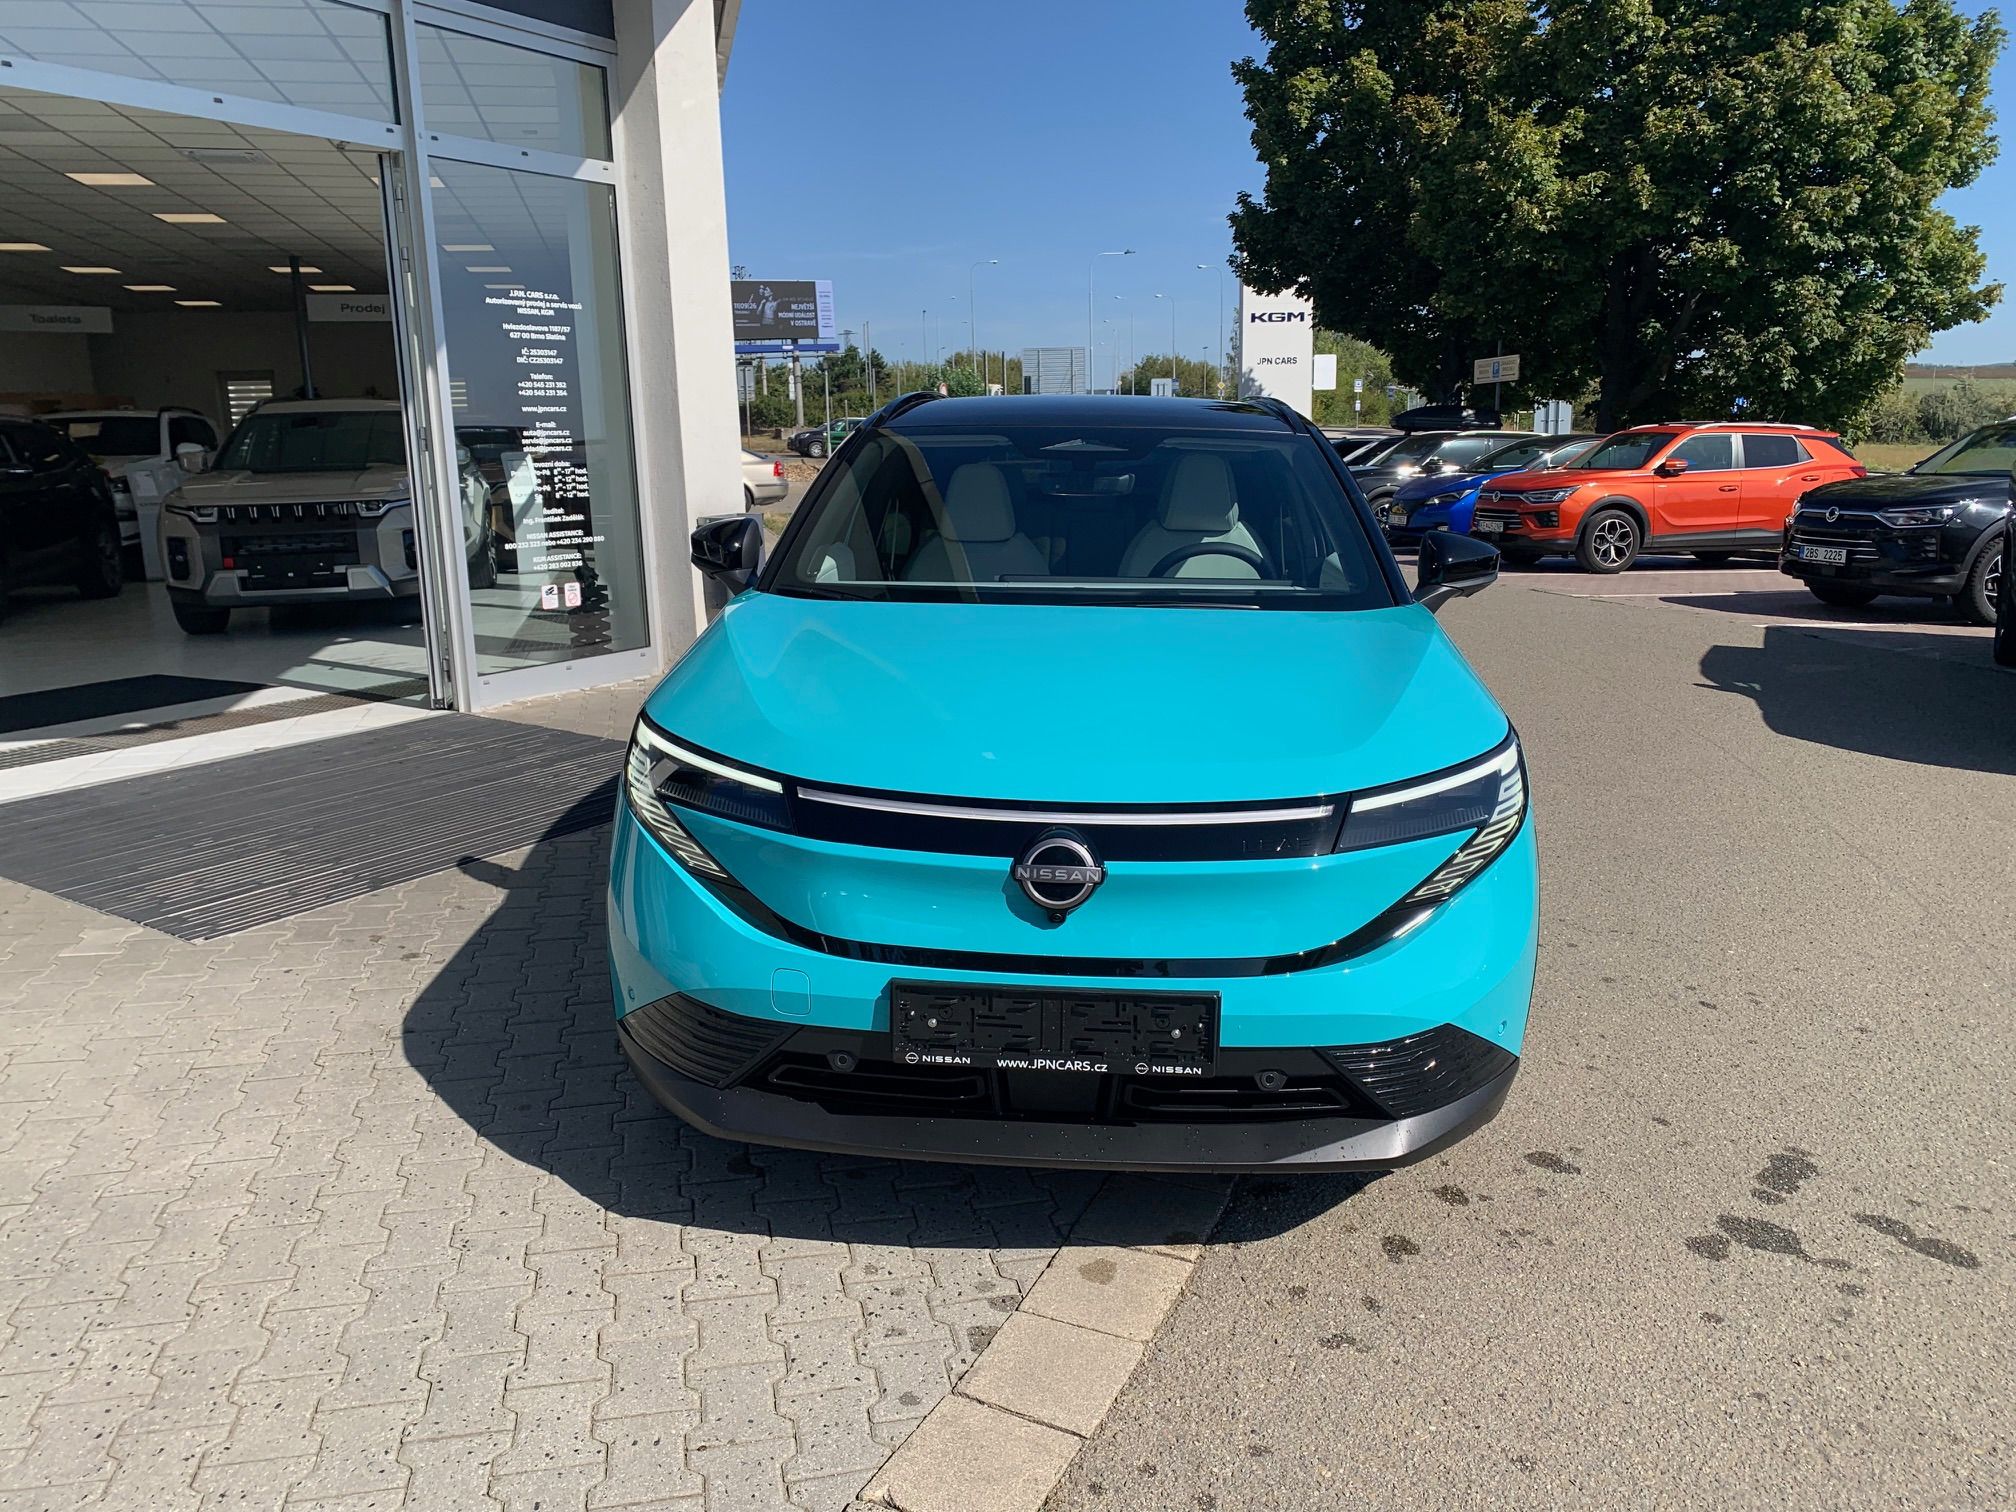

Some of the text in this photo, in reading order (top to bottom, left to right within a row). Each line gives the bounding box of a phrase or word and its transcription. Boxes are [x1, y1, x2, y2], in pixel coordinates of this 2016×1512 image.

[485, 297, 526, 306] Autorizovaný
[526, 300, 546, 308] prodej
[340, 303, 385, 315] Prodej
[29, 313, 82, 324] Toaleta
[1250, 312, 1305, 322] KGM
[502, 323, 548, 332] Hviezdoslavova
[1257, 357, 1298, 365] JPN CARS
[522, 406, 568, 414] www.jpncars.cz
[522, 445, 573, 453] sklad@jpncars.cz
[526, 530, 584, 540] NISSAN ASSISTANCE:
[546, 552, 582, 562] ASSISTANCE:
[1805, 548, 1842, 560] 2BS 2225
[1017, 867, 1099, 882] NISSAN
[922, 1055, 971, 1064] NISSAN
[996, 1058, 1108, 1072] www.JPNCARS.cz
[1152, 1066, 1202, 1076] NISSAN
